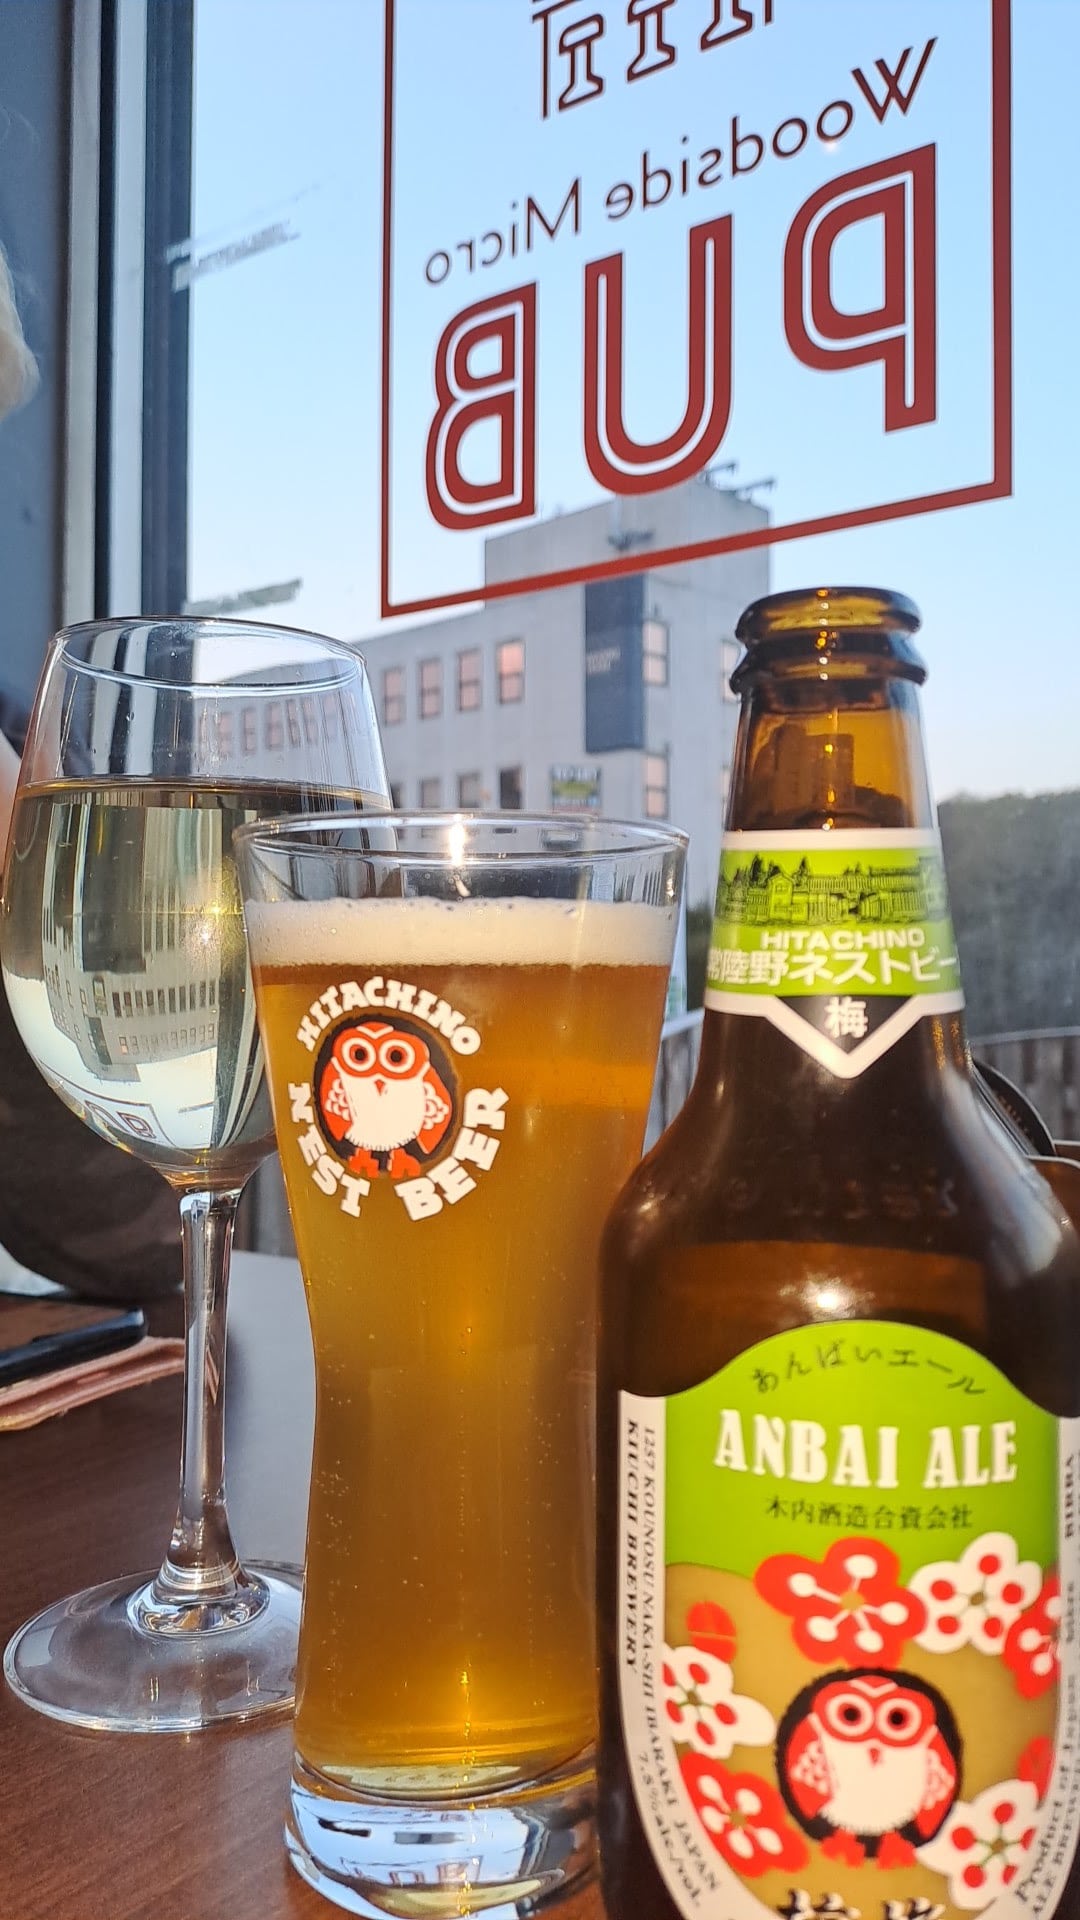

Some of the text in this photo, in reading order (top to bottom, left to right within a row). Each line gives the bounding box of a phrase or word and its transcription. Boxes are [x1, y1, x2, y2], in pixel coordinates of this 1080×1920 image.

[760, 928, 926, 951] HITACHINO
[296, 976, 482, 1056] HITACHINO
[824, 996, 868, 1038] 梅
[288, 1082, 510, 1222] NEST BEER
[752, 1340, 986, 1395] あんばいエール
[643, 1427, 656, 1468] 1257
[713, 1408, 1018, 1489] ANBAI ALE
[625, 1418, 640, 1674] KIUCHI BREWERY
[643, 1476, 656, 1588] KOUNOSU
[645, 1706, 679, 1807] IBARAKI
[674, 1820, 721, 1892] JAPAN
